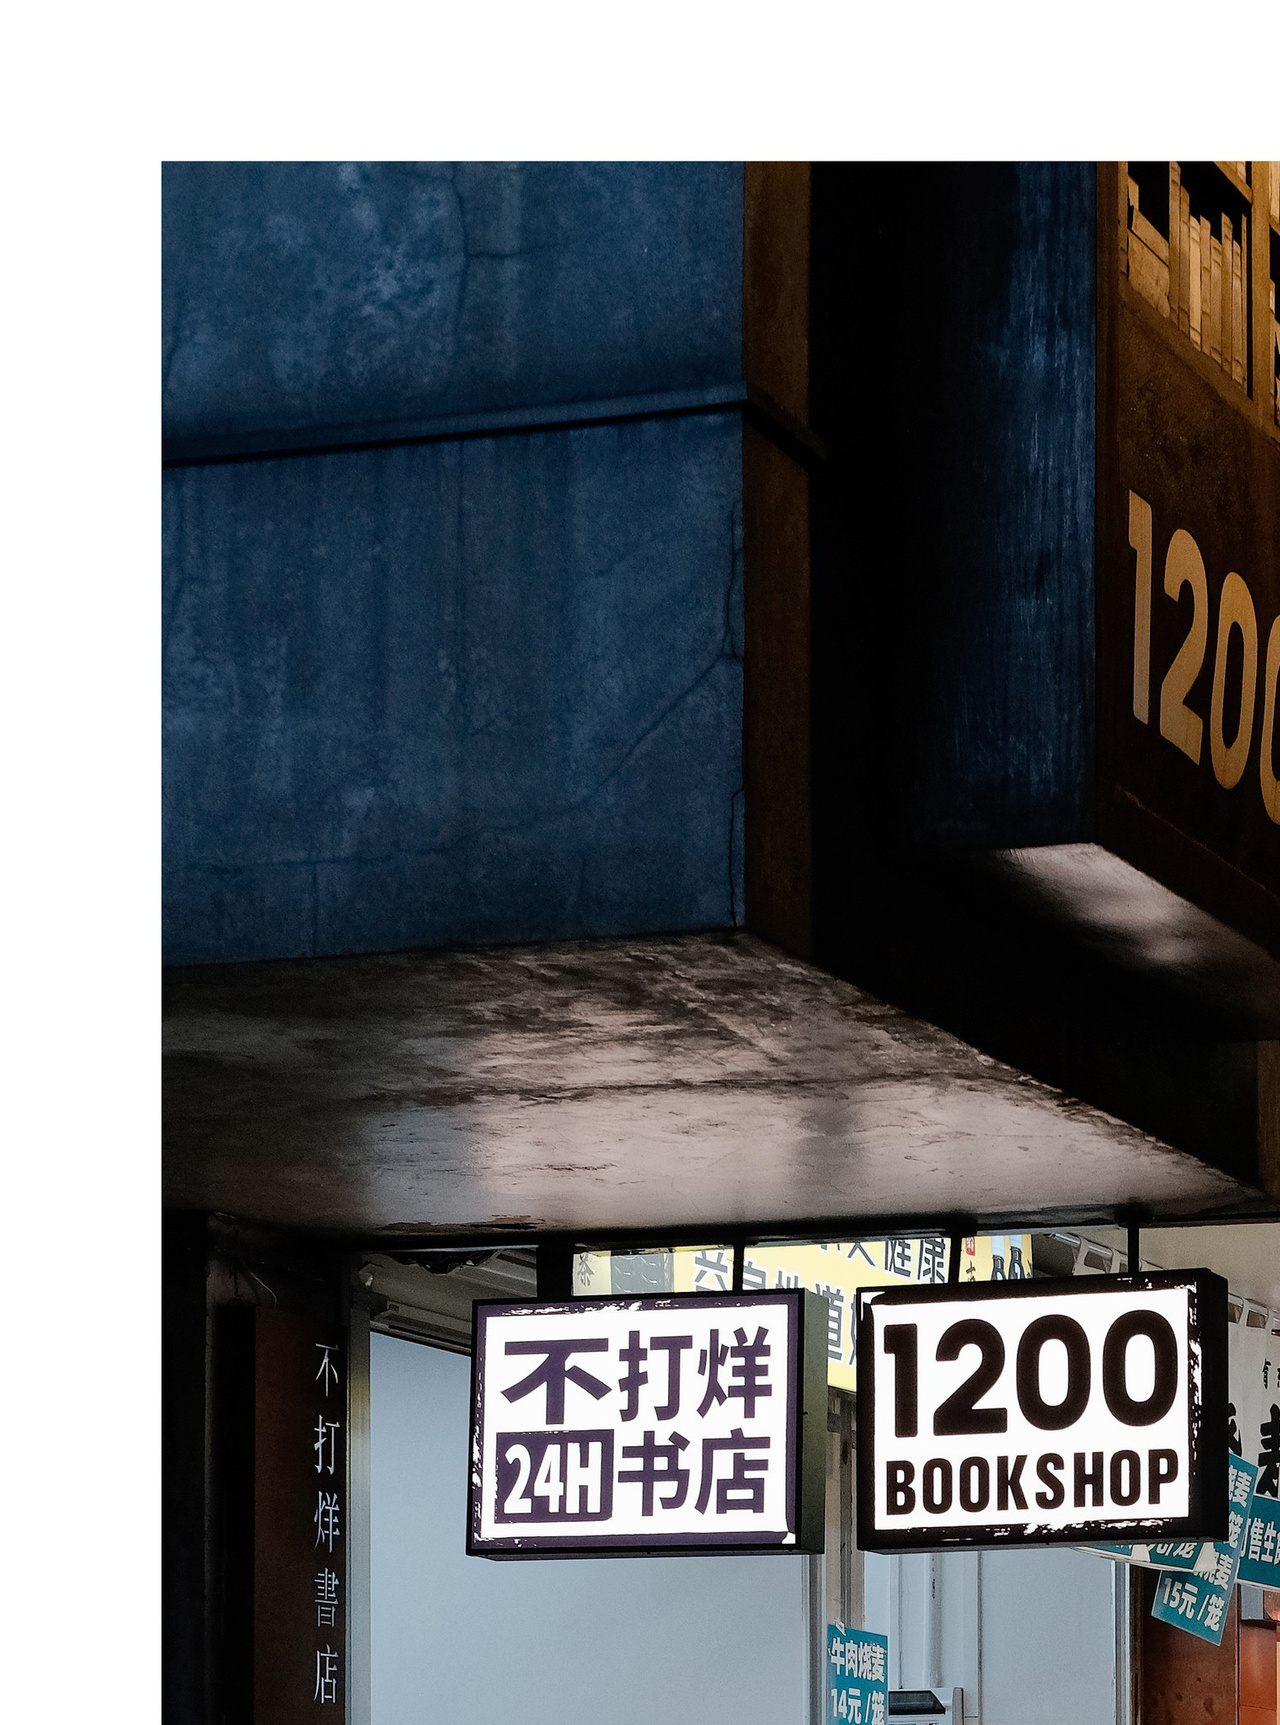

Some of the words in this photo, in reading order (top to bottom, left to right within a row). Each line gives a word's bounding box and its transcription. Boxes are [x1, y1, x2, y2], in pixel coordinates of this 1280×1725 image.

[501, 1326, 773, 1425] 不打烊
[883, 1310, 1179, 1438] 1200
[504, 1441, 601, 1514] 24H
[617, 1429, 767, 1517] 书店
[886, 1448, 1178, 1515] BOOKSHOP
[314, 1342, 341, 1705] 不打烊書店
[830, 1637, 886, 1683] 牛肉烧麦
